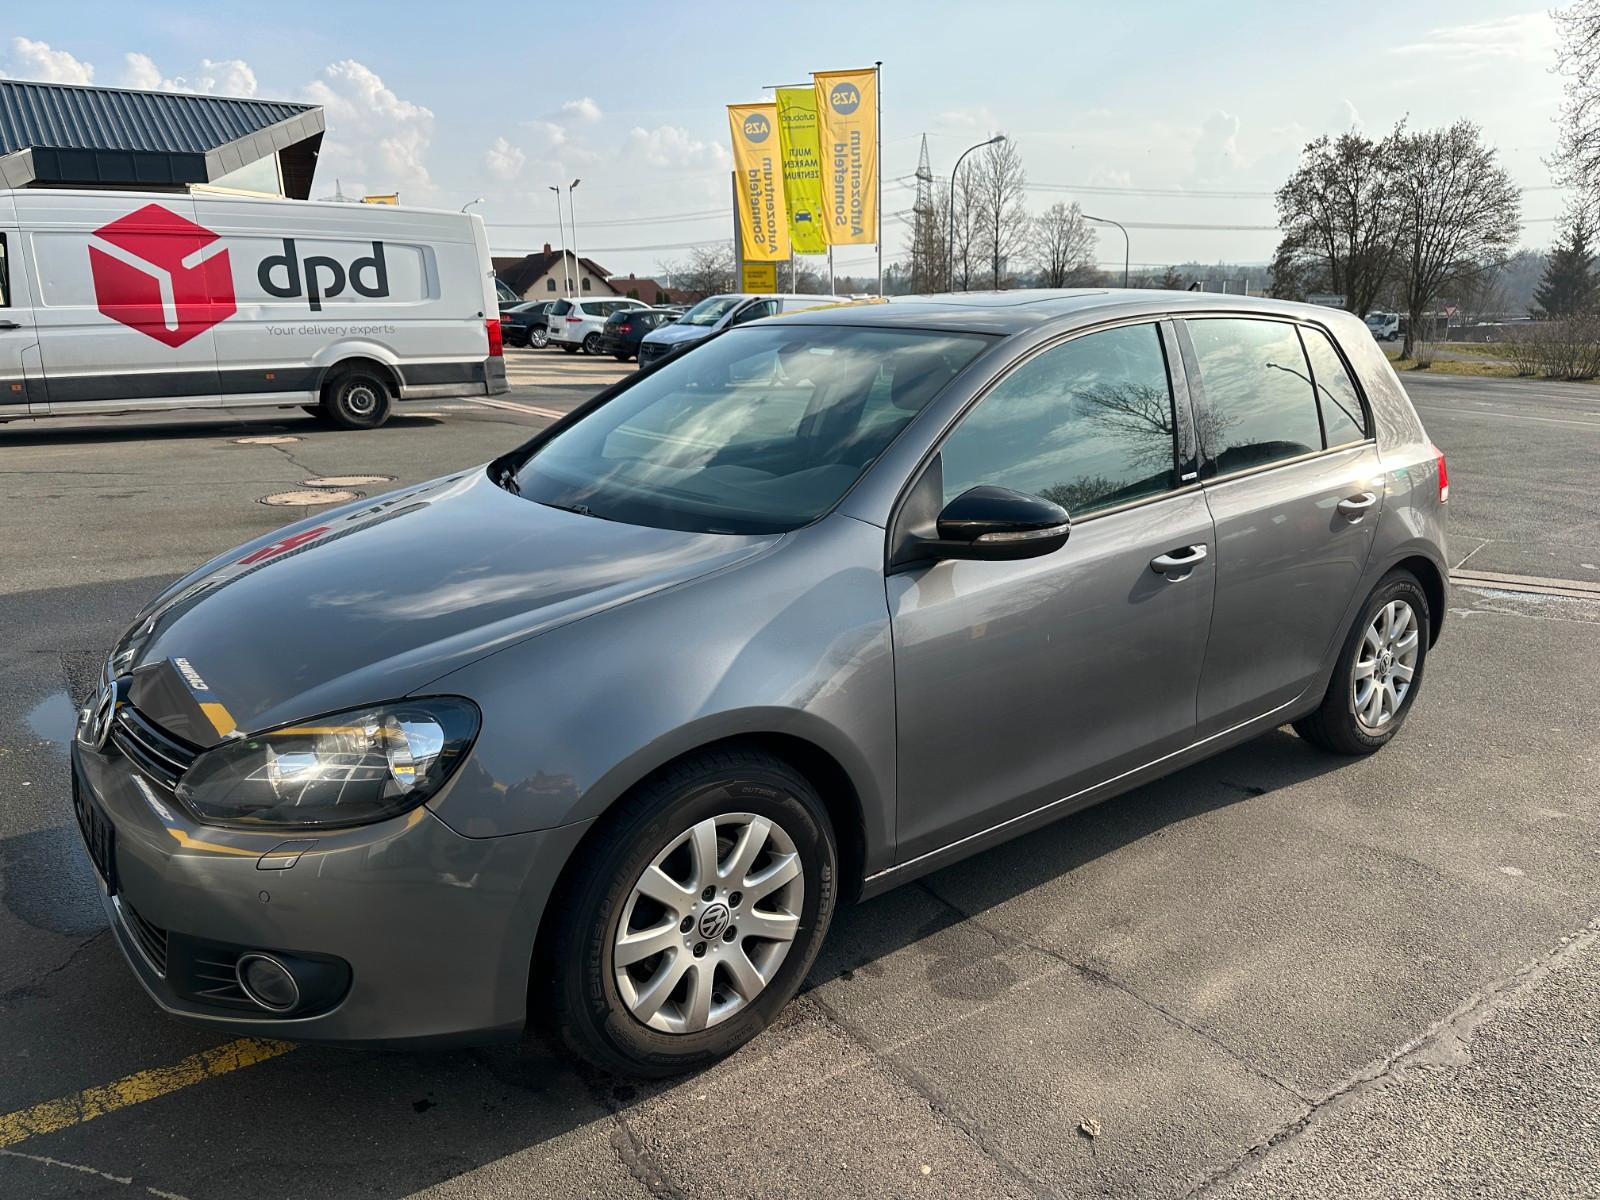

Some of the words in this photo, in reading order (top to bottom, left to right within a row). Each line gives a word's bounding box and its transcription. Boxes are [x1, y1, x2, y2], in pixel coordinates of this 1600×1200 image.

[257, 238, 389, 311] dpd
[265, 326, 295, 335] Your
[298, 325, 347, 337] delivery
[350, 324, 395, 336] experts
